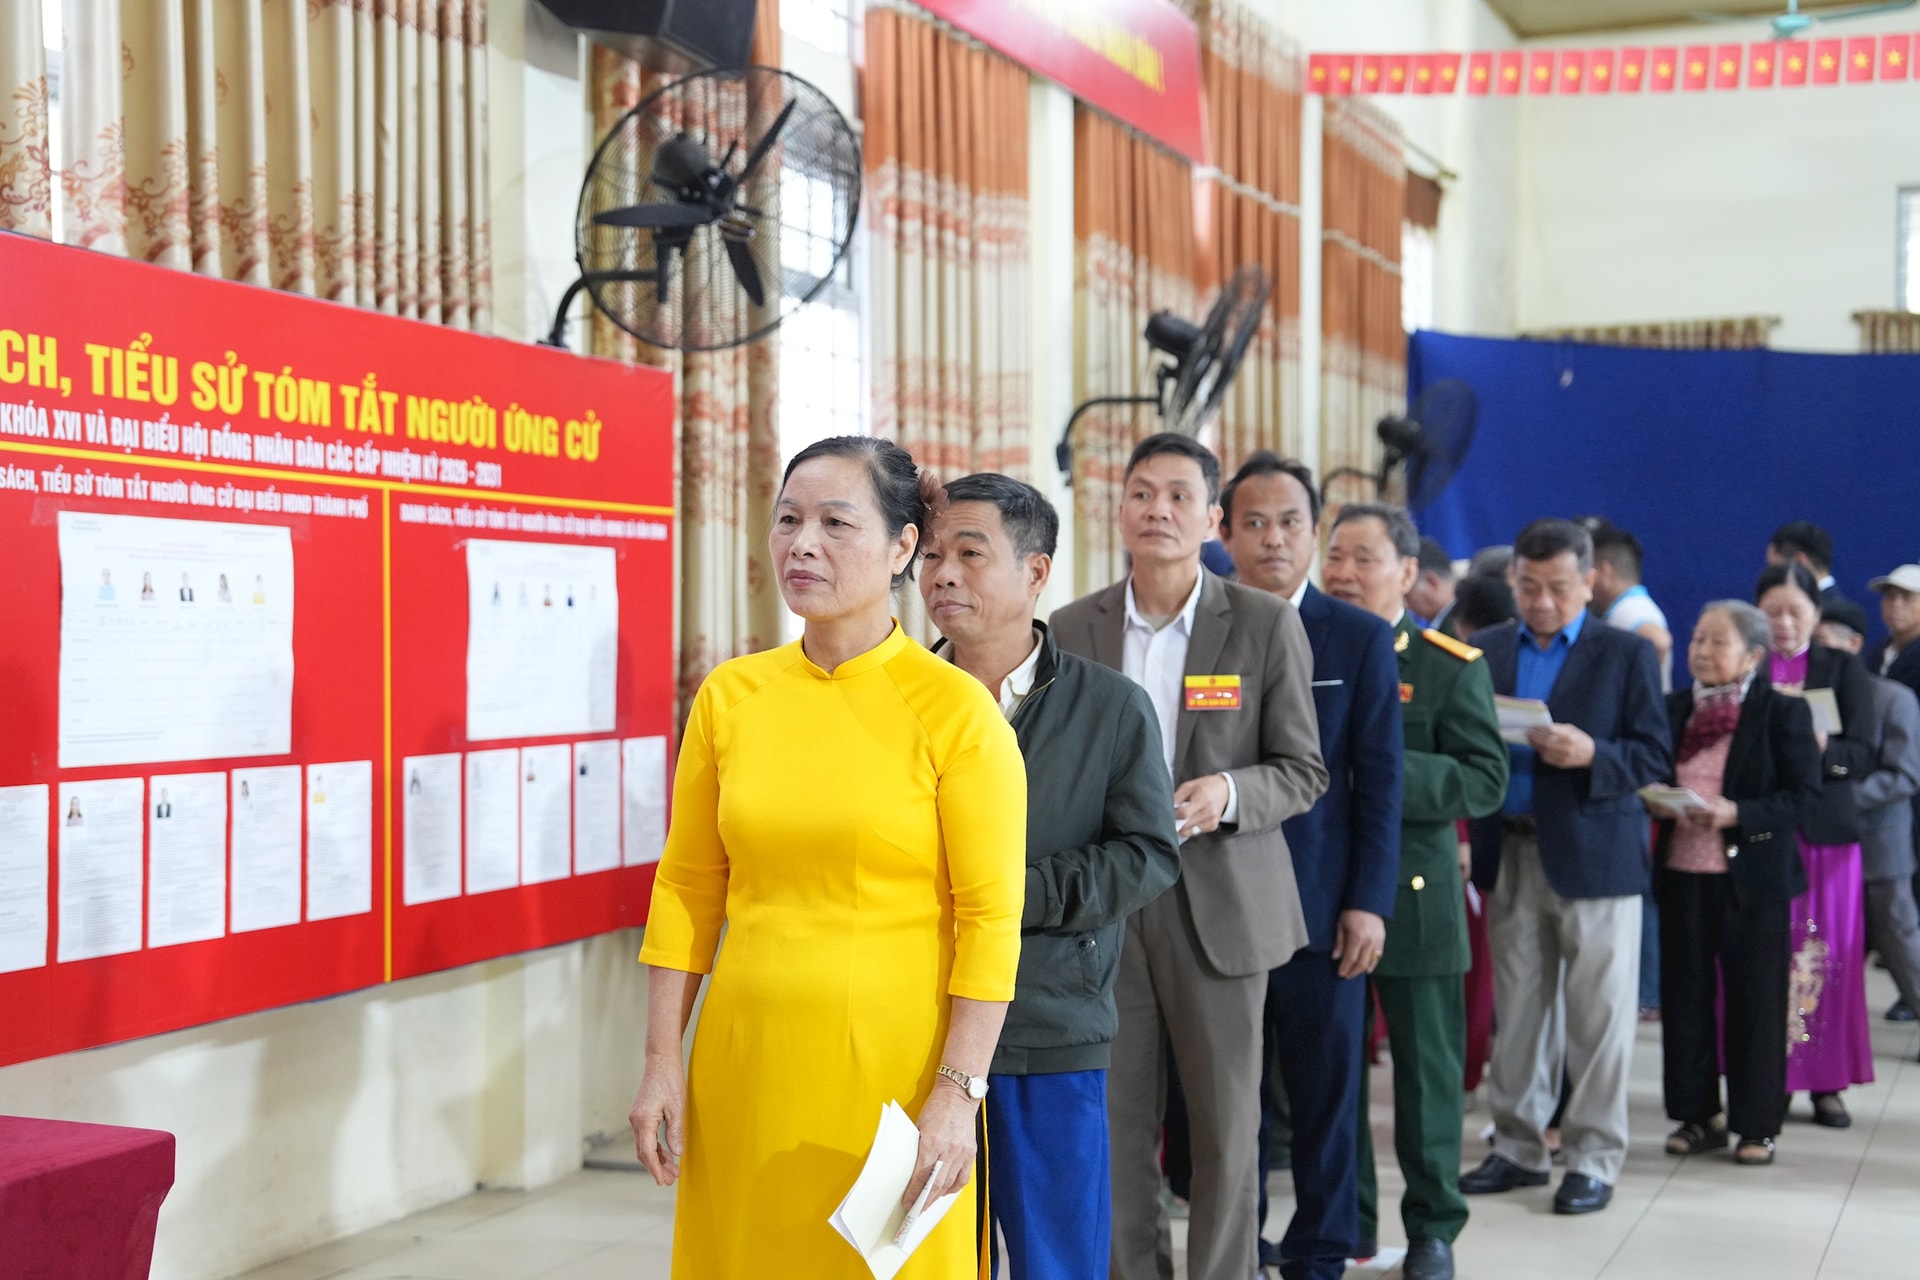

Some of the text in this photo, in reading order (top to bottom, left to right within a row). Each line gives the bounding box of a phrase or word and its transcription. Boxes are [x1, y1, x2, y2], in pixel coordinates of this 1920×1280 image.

[85, 332, 178, 406] TIỂU
[191, 350, 248, 415] SỬ
[253, 366, 332, 427] TÓM
[340, 372, 399, 436] TẮT
[406, 395, 497, 449] NGƯỜI
[503, 402, 560, 458] ỨNG
[565, 409, 602, 462] CỬ
[0, 400, 49, 438] KHÓA
[53, 408, 82, 442] XVI
[84, 408, 108, 445] VÀ
[110, 416, 139, 454] ĐẠI
[142, 412, 179, 453] BIỂU
[182, 421, 209, 462] HỘI
[254, 432, 294, 466] NHÂN
[295, 435, 325, 469] DÂN
[326, 439, 353, 472] CÁC
[354, 439, 380, 475] CẤP
[381, 447, 421, 484] NHIỆM
[0, 463, 39, 494] SÁCH,
[41, 464, 71, 494] TIỂU
[73, 468, 95, 496] SỬ
[95, 473, 124, 498] TÓM
[125, 472, 149, 500] TẮT
[150, 479, 188, 504] NGƯỜI
